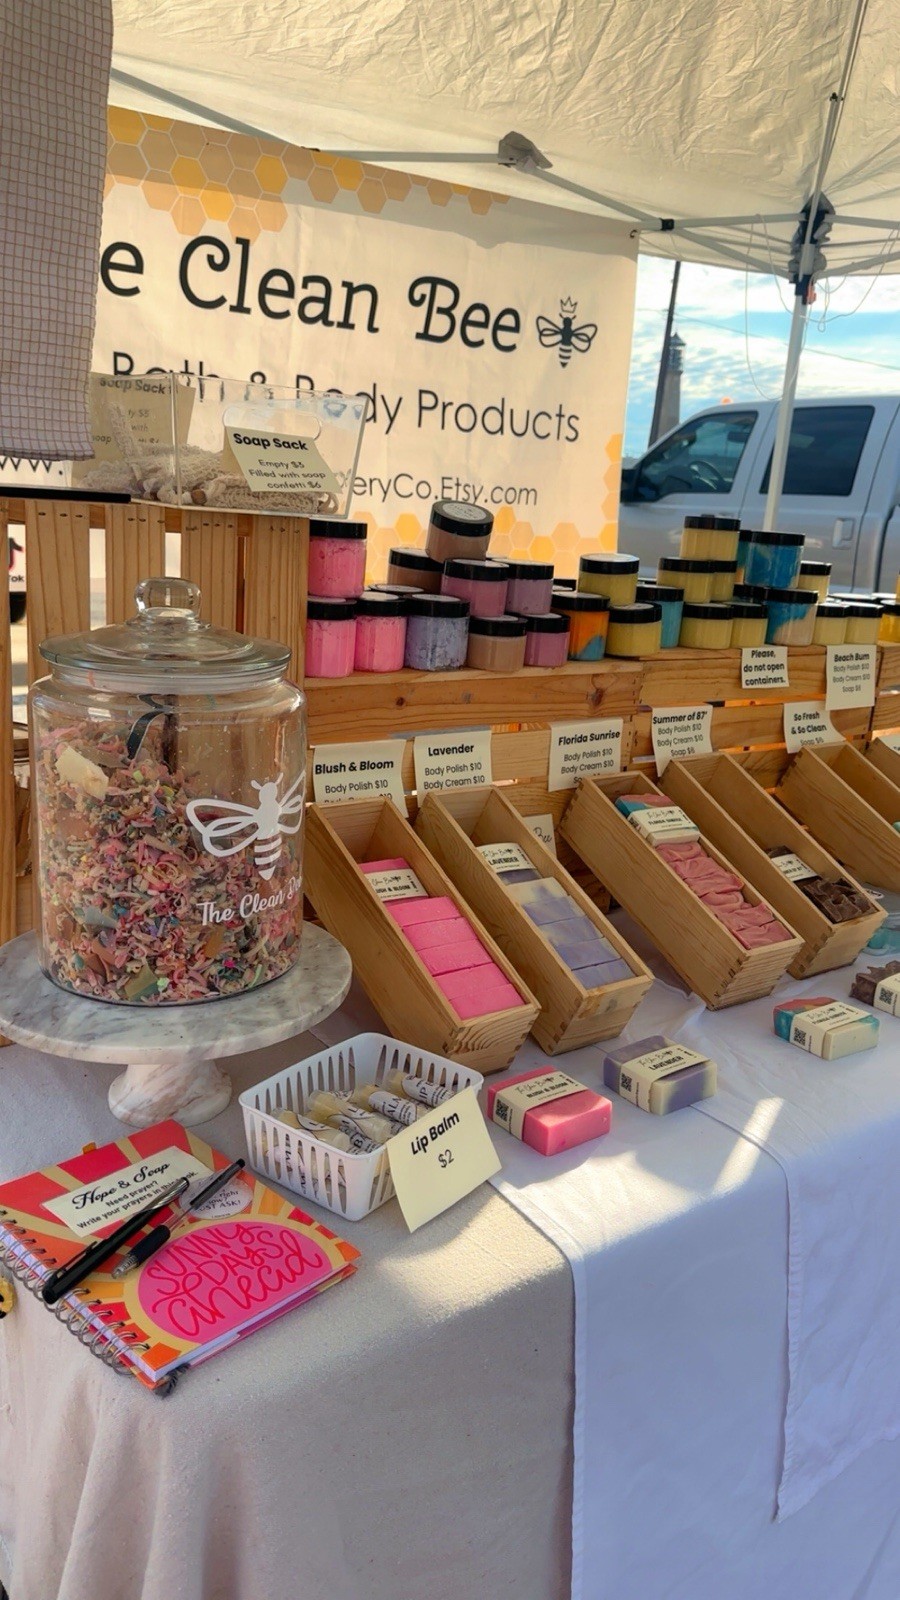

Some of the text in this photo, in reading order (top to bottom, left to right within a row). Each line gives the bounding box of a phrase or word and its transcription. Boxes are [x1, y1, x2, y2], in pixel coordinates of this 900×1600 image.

[178, 234, 379, 334] Clean
[408, 275, 521, 353] Bee
[417, 389, 580, 443] Products
[233, 433, 308, 450] Soap Sack
[258, 459, 289, 470] Empty
[249, 469, 276, 478] Filled
[267, 481, 305, 489] confetti
[353, 473, 538, 506] eryCo.Etsy.com
[751, 649, 776, 659] Please,
[834, 652, 870, 662] Beach Bum
[743, 663, 785, 673] do not open
[745, 676, 786, 686] containers.
[653, 713, 686, 724] Summer
[687, 712, 696, 721] of
[794, 711, 820, 721] So Fresh
[658, 722, 702, 735] Body Polish $10
[791, 724, 827, 735] & So Clean
[558, 730, 620, 746] Florida Sunrise
[657, 734, 704, 748] Body Cream $10
[428, 743, 474, 756] Lavender
[564, 748, 613, 762] Body Polish $10
[671, 748, 687, 757] Soap
[315, 759, 394, 775] Blush & Bloom
[424, 761, 482, 777] Body Polish $10
[561, 759, 614, 774] Body Cream $10
[325, 779, 388, 795] Body Polish $10
[423, 775, 485, 790] Body Cream $10
[488, 856, 519, 865] LAVENDER
[196, 901, 235, 926] The
[239, 890, 286, 918] Clean
[649, 1055, 684, 1070] LAVENDER
[411, 1135, 429, 1155] Lip
[429, 1112, 460, 1141] Balm
[438, 1148, 455, 1168] $2
[72, 1162, 170, 1210] Hope & Soap
[106, 1180, 159, 1208] Need prayer?
[77, 1215, 102, 1229] Write
[102, 1206, 121, 1220] your
[122, 1192, 152, 1212] prayers
[151, 1189, 159, 1198] in
